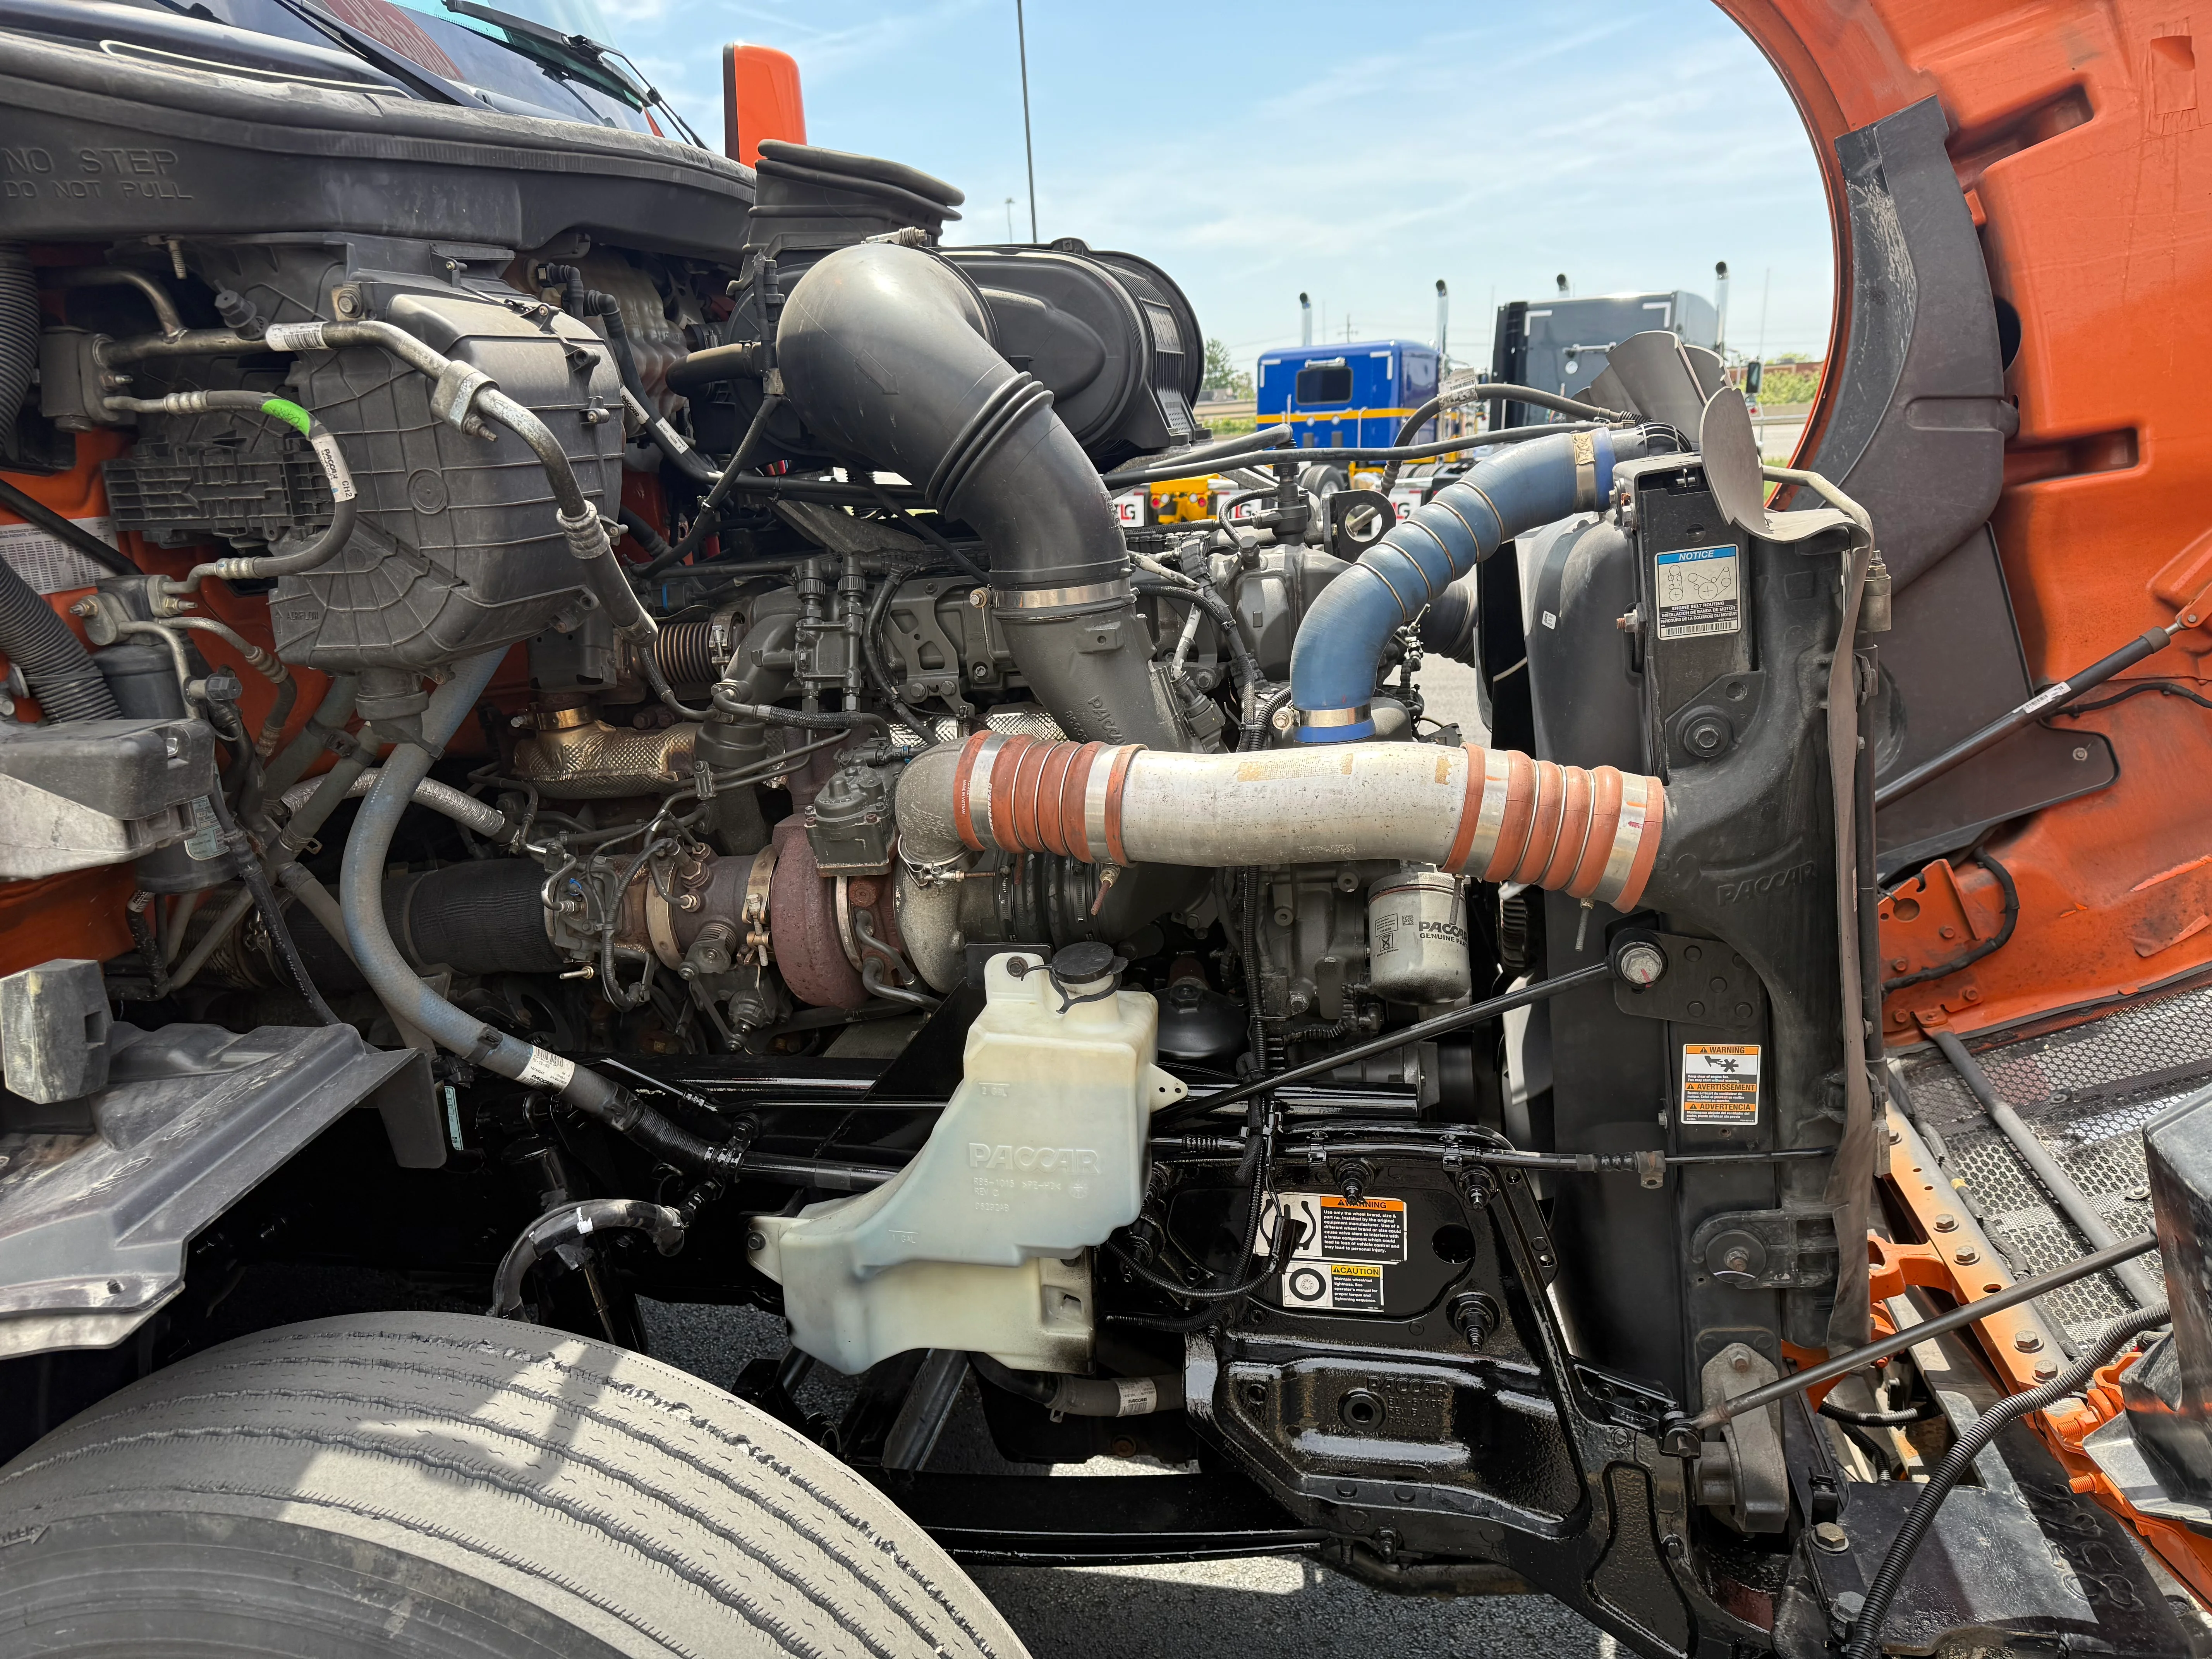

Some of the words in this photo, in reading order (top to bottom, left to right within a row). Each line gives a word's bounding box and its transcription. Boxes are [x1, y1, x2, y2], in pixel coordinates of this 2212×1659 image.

[2, 148, 54, 174] NO
[80, 149, 179, 175] STEP
[4, 181, 37, 198] DO
[55, 181, 101, 198] NOT
[122, 182, 193, 199] PULL
[622, 395, 639, 417] PACCAR
[324, 448, 338, 479] PACCAR
[342, 481, 352, 498] CH2
[1115, 503, 1135, 520] LG
[1679, 550, 1714, 561] NOTICE
[287, 611, 319, 620] AIRFLOW
[1088, 695, 1126, 745] PACCA
[1717, 860, 1816, 906] PACCAR
[1420, 933, 1455, 942] GENUINE
[531, 1074, 554, 1086] PACCAR
[969, 1142, 1100, 1173] PACCAR
[974, 1188, 988, 1196] REV
[900, 1234, 916, 1244] GAL
[1367, 1376, 1448, 1396] PACCAR
[1388, 1406, 1407, 1415] REV
